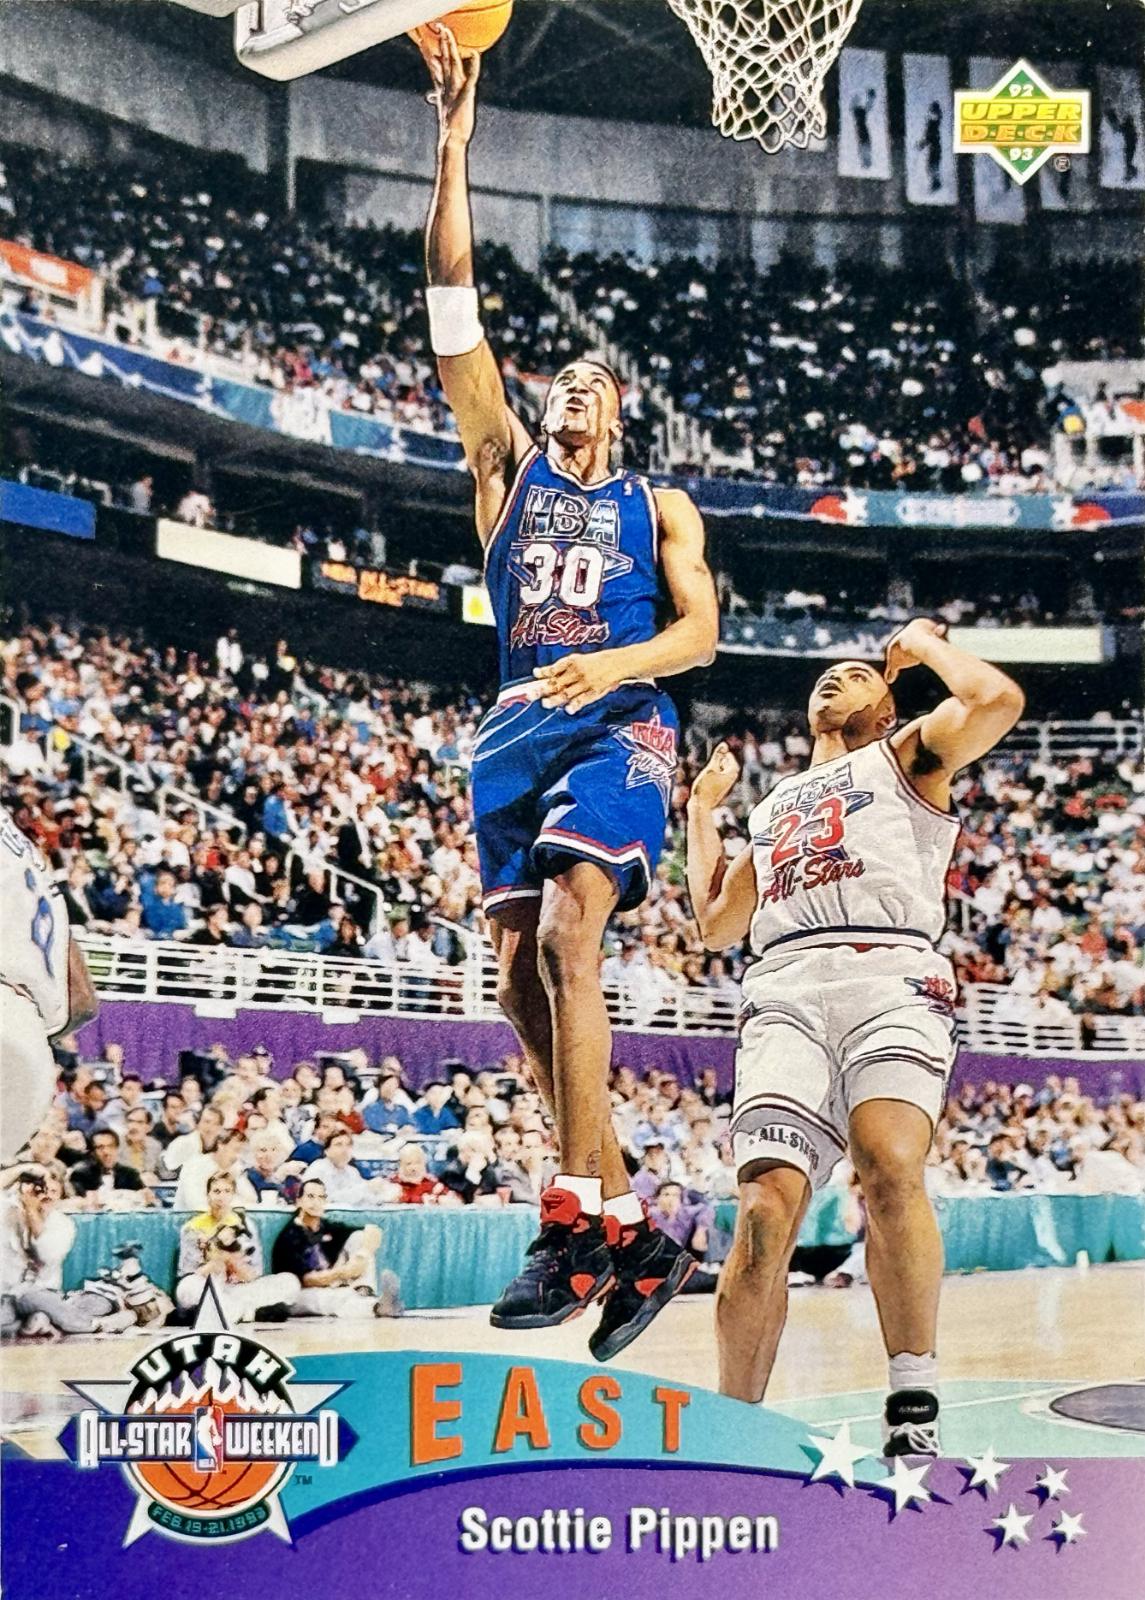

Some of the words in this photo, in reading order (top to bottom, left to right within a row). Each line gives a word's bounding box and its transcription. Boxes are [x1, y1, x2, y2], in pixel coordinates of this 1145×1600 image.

[518, 485, 620, 550] NBA
[519, 542, 605, 608] 30
[771, 796, 845, 867] 23
